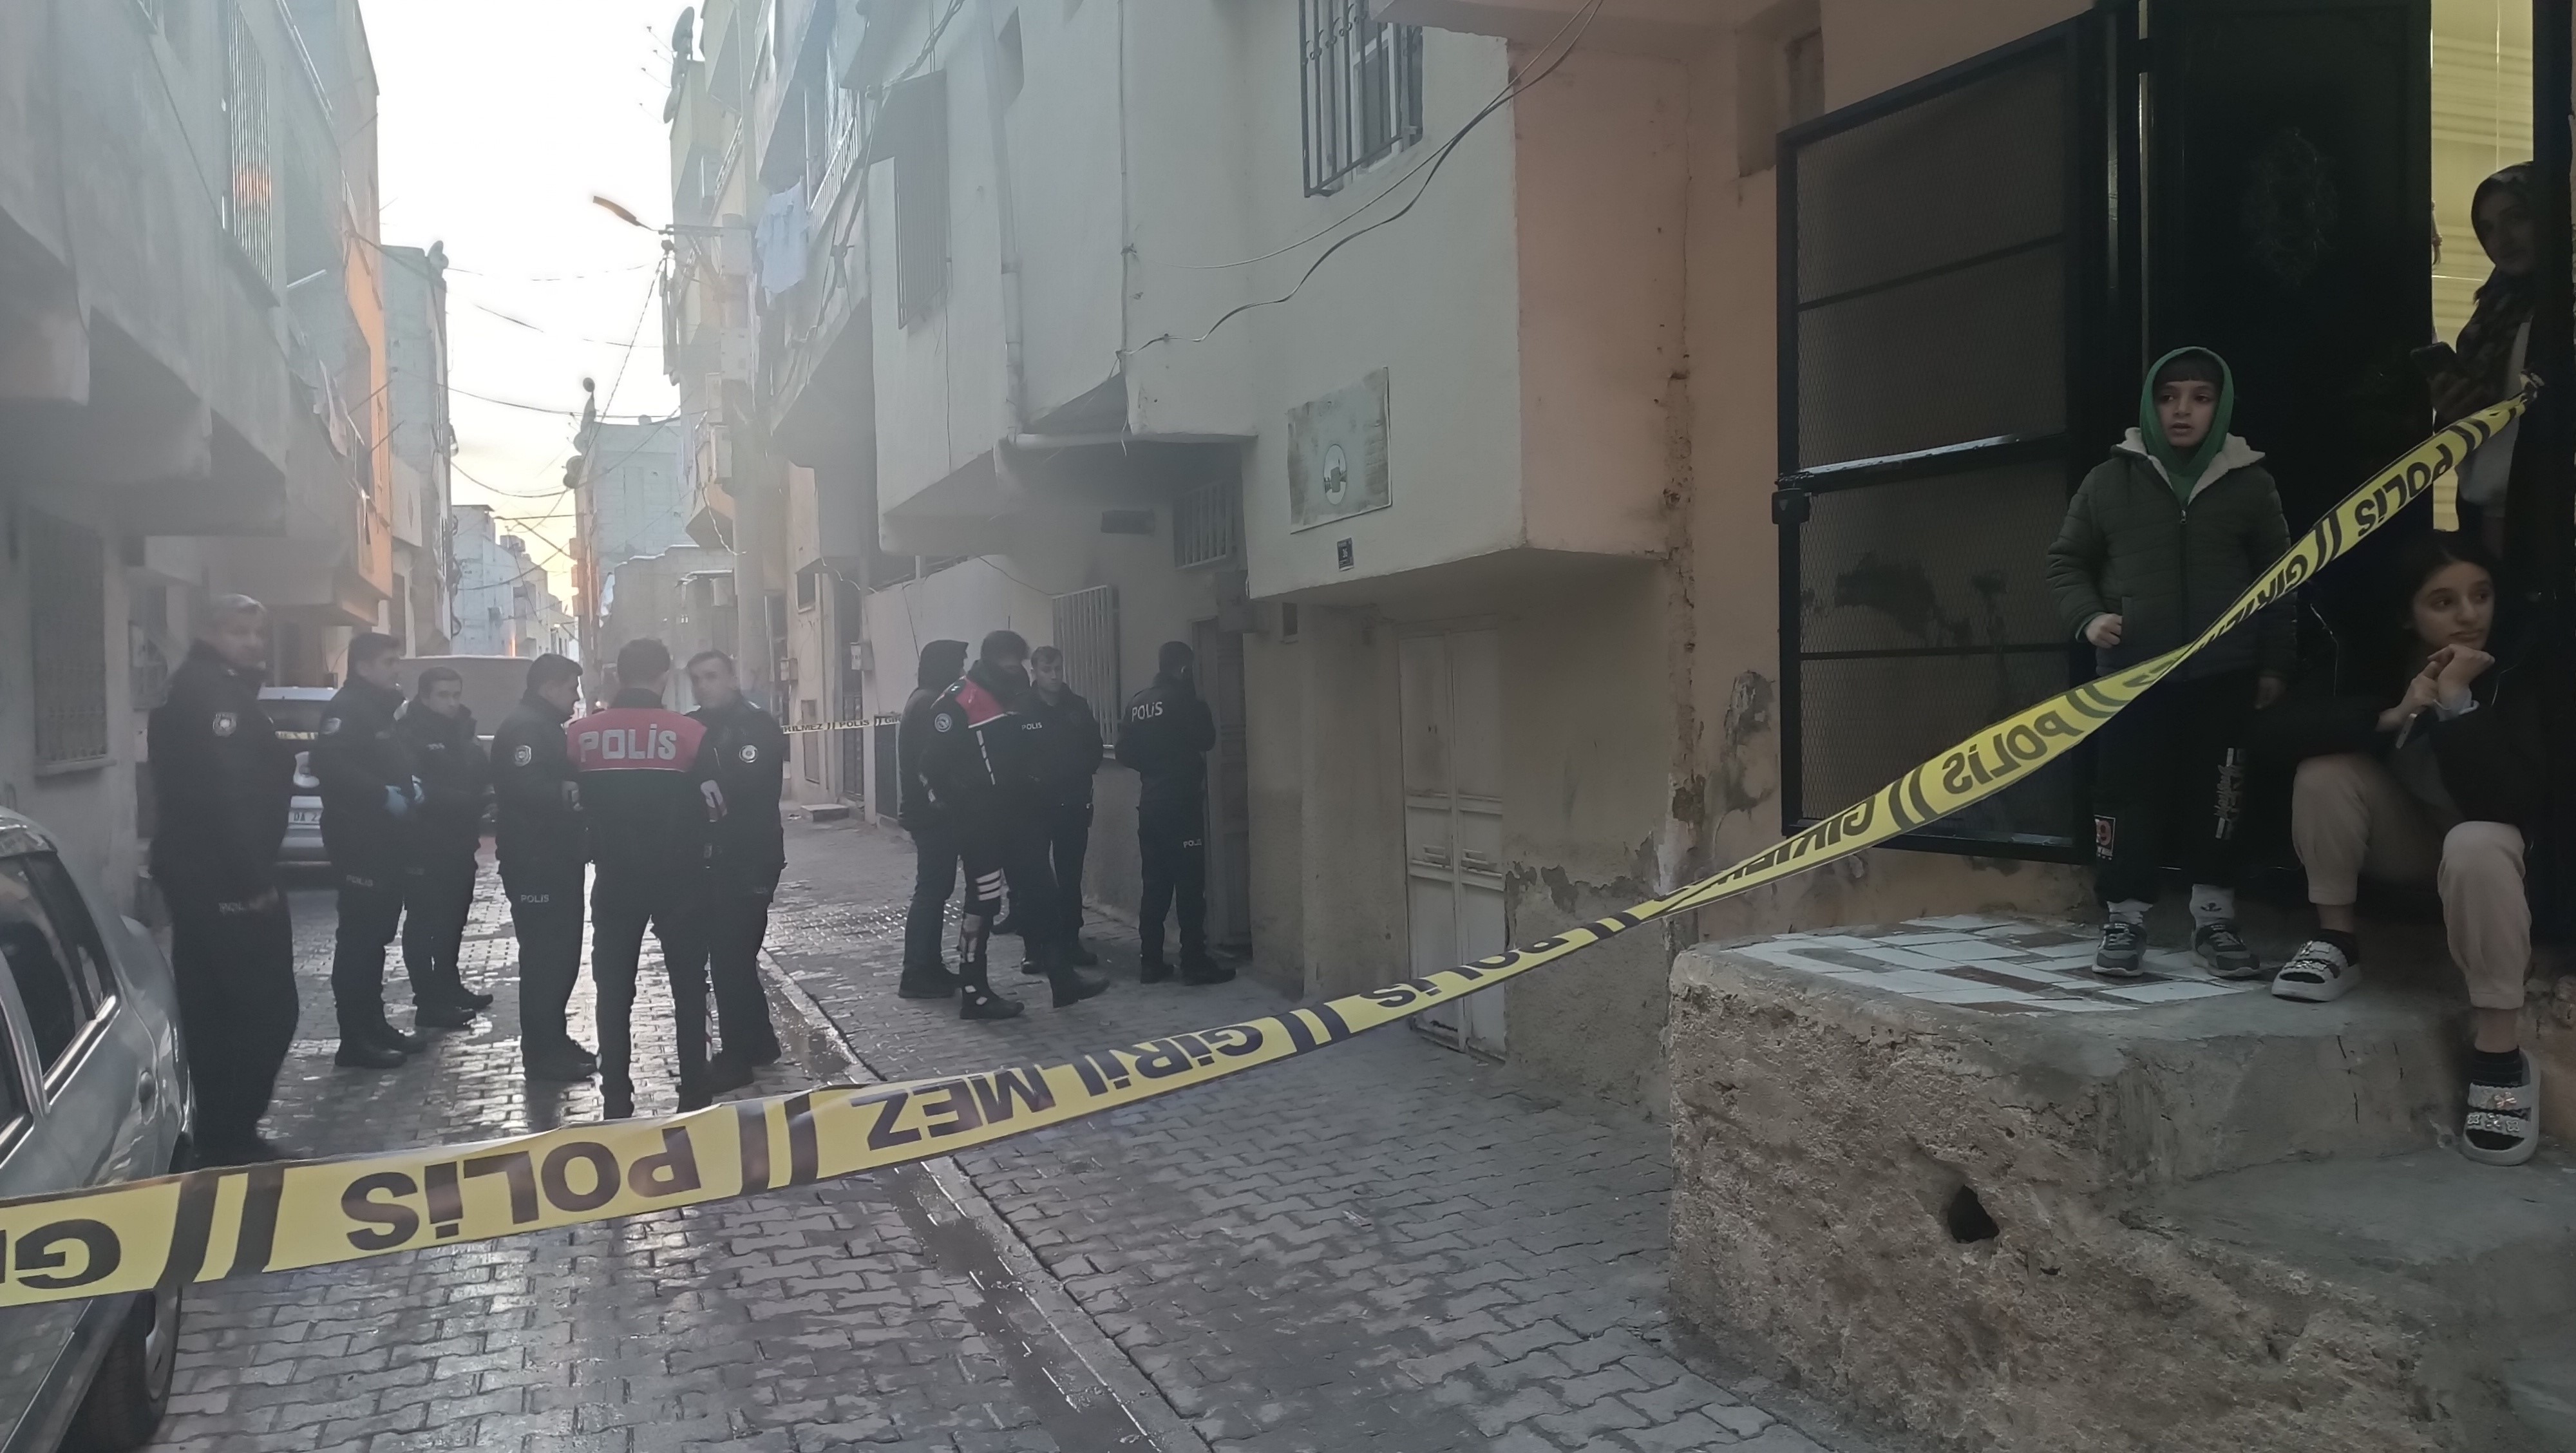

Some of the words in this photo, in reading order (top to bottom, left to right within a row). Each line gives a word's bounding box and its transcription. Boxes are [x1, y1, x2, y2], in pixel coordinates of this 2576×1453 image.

[578, 723, 677, 763] POLİS
[1131, 701, 1163, 722] POLİS
[850, 1023, 1264, 1150] GİRİLMEZ
[340, 1126, 701, 1251] POLİS
[0, 1218, 121, 1289] G
